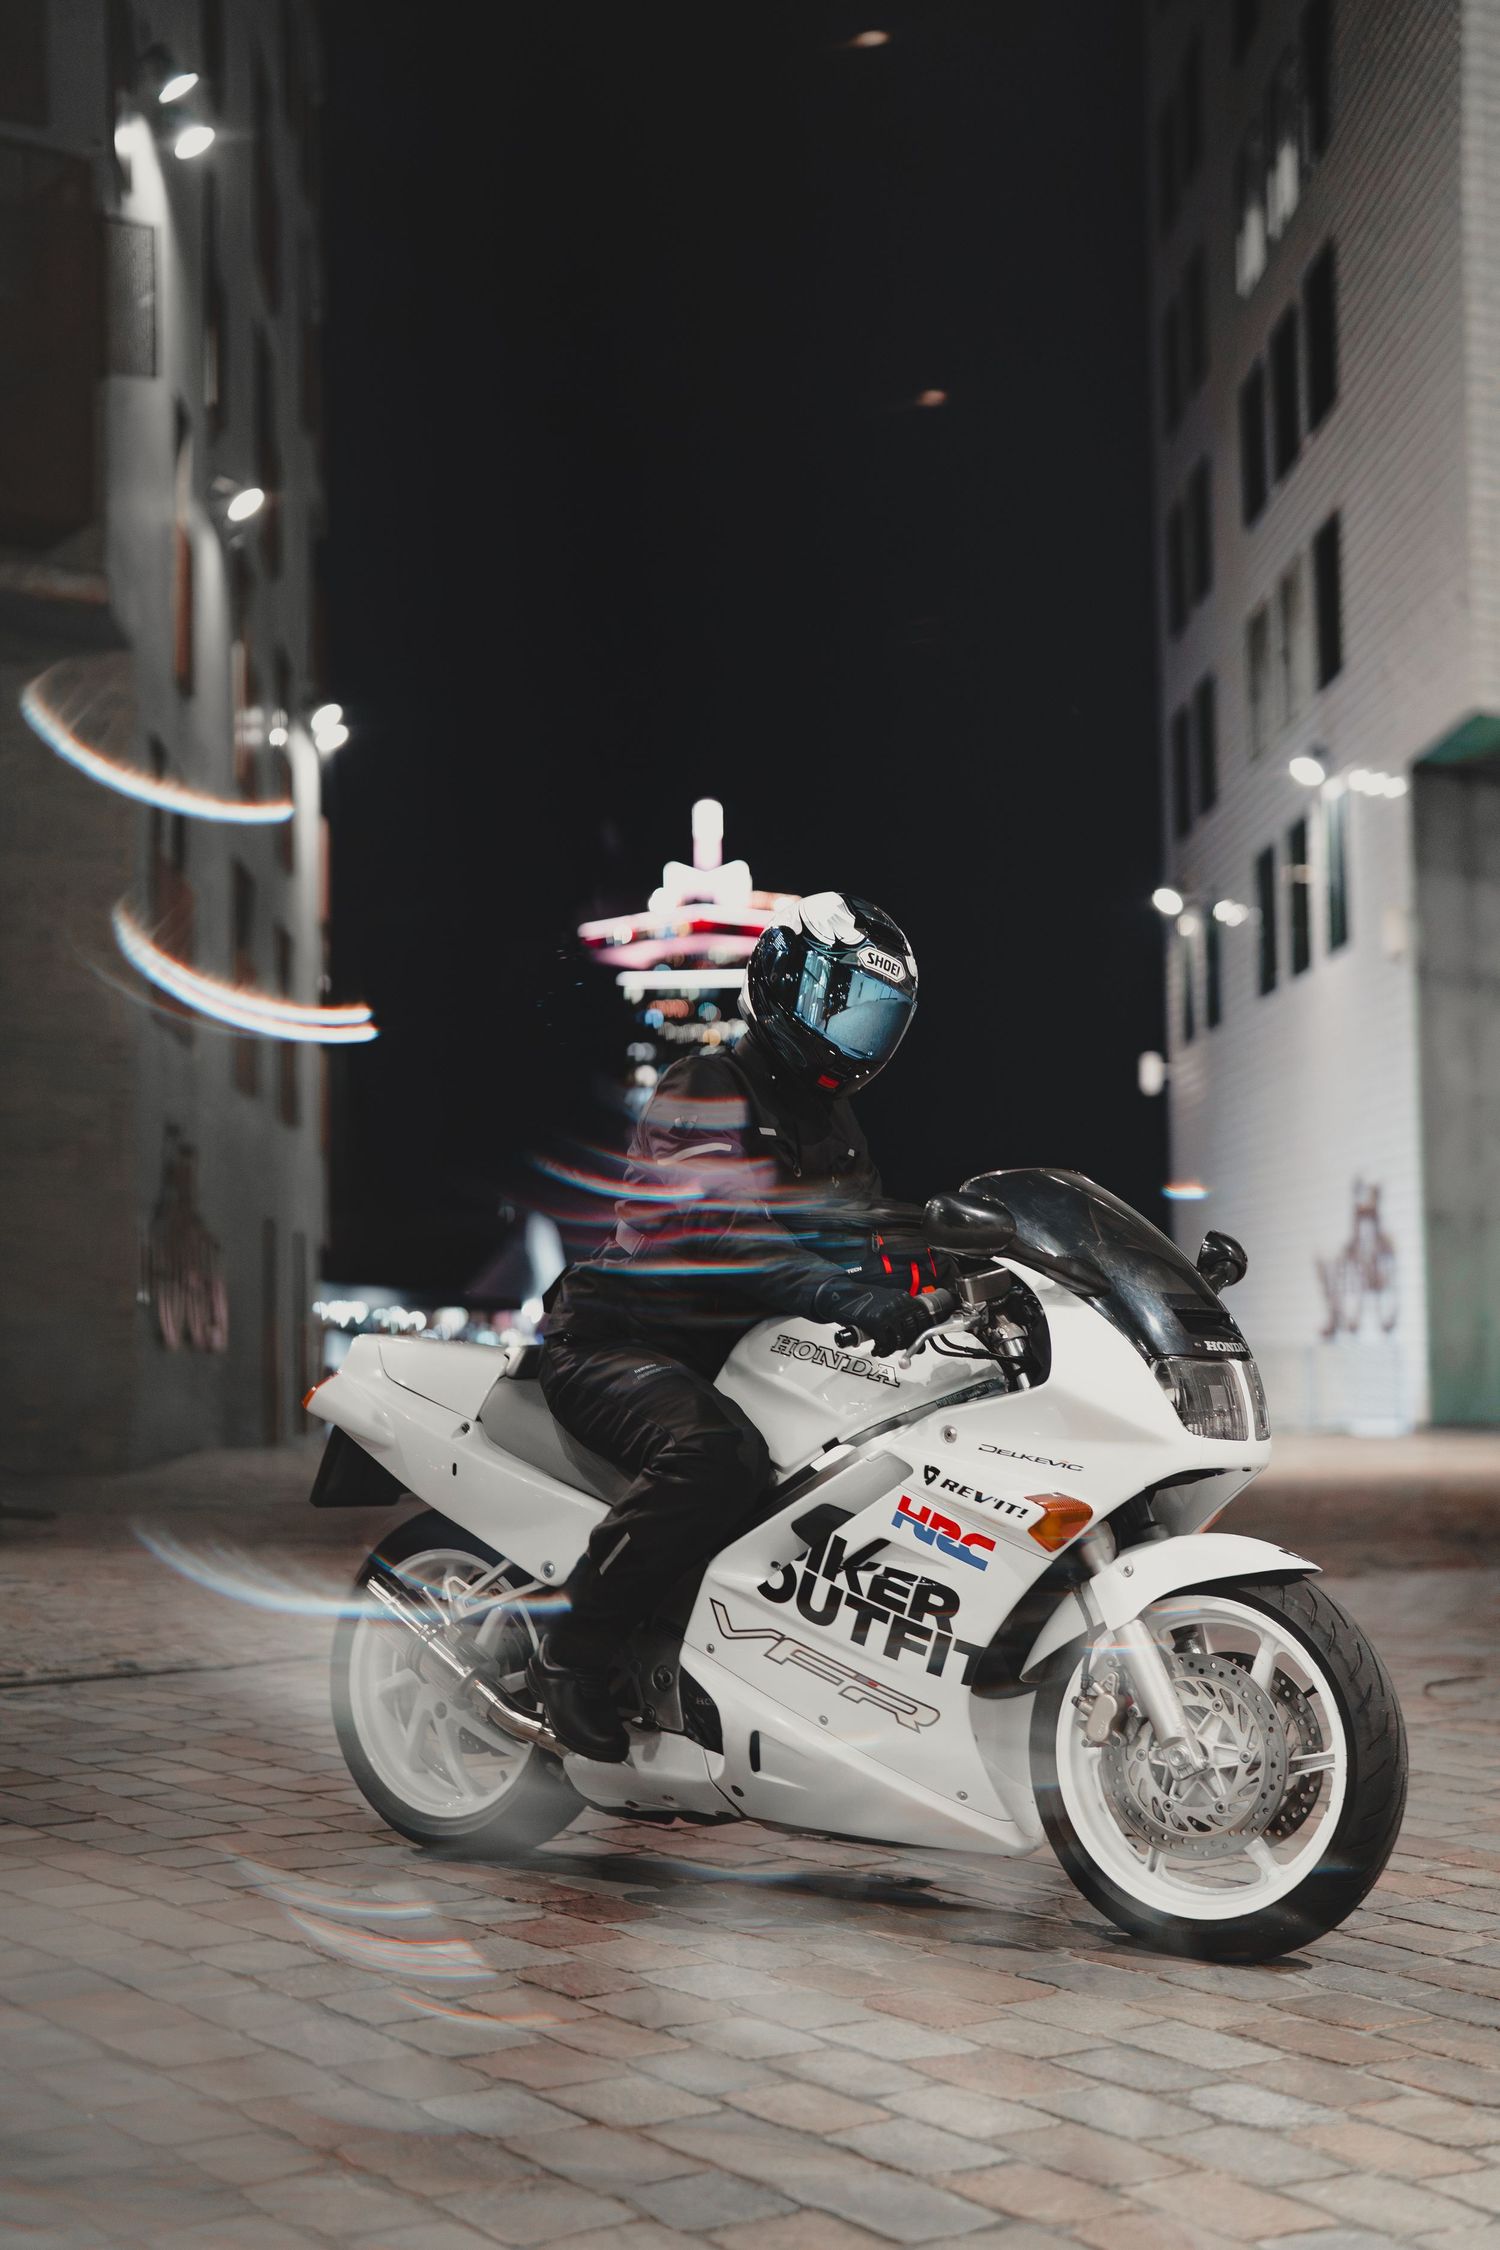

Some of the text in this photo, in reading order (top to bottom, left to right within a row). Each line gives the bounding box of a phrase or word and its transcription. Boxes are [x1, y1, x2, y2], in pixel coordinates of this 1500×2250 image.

[866, 952, 900, 976] SHOEI
[770, 1334, 900, 1387] HONDA
[1204, 1340, 1246, 1352] HONDA
[978, 1443, 1084, 1471] DELKEVIC
[940, 1478, 1029, 1518] REV'IT!
[891, 1495, 996, 1571] HRC
[709, 1598, 941, 1733] VFR
